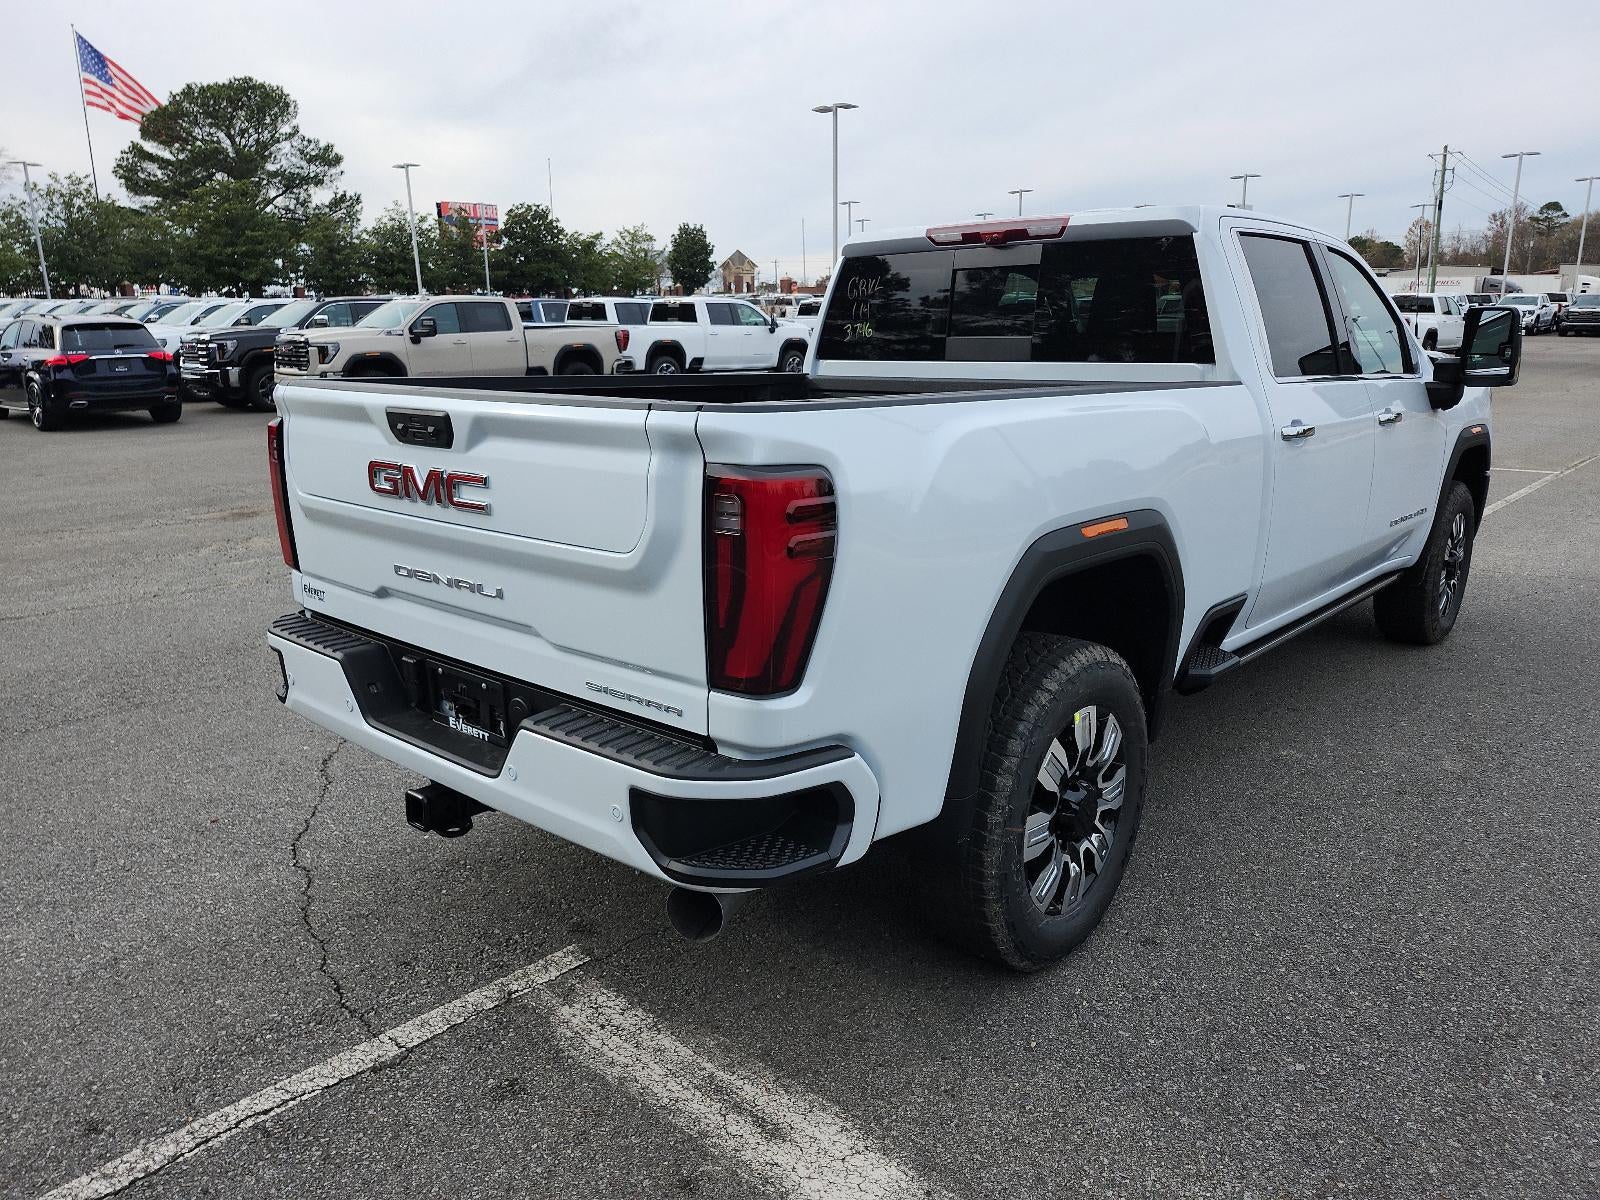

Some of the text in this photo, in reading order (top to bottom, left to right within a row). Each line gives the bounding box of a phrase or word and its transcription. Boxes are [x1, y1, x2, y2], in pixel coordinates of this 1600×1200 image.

[368, 459, 491, 515] GMC
[303, 582, 326, 598] EVERETT
[394, 564, 503, 599] DENALI
[585, 680, 683, 717] SIERRA
[449, 714, 490, 742] EVERETT
